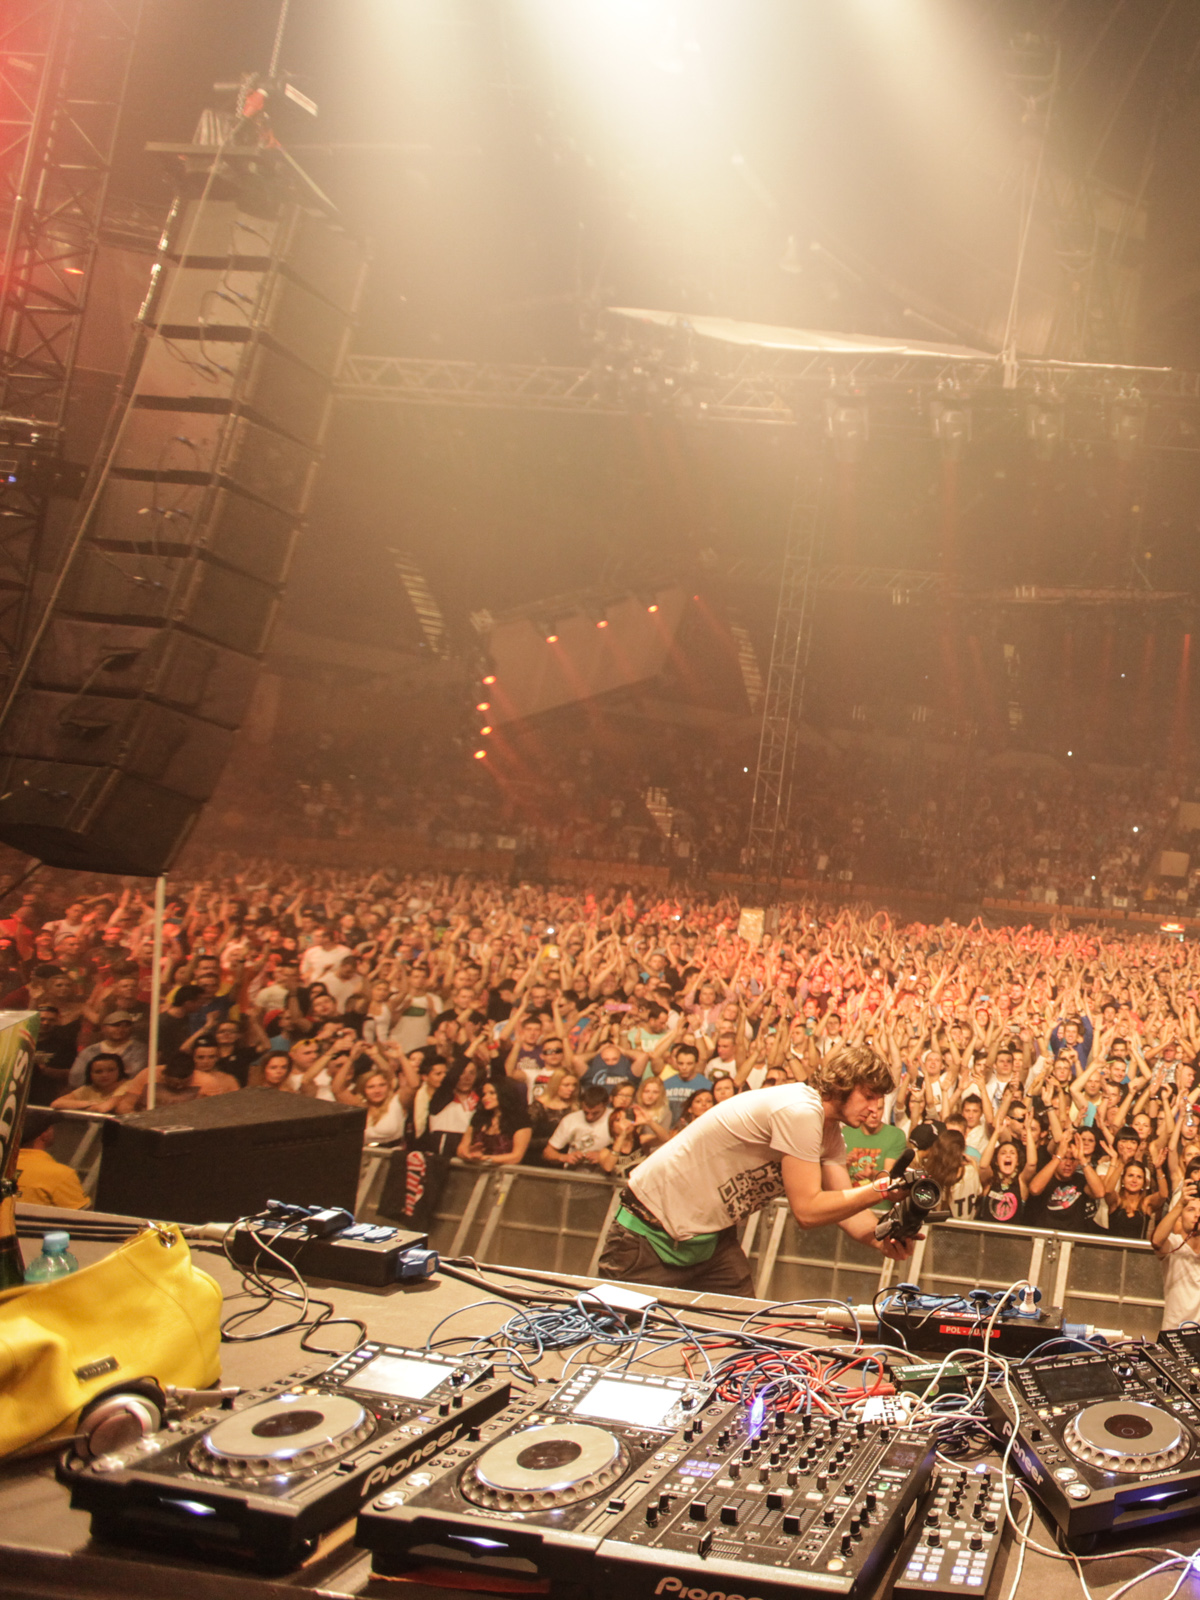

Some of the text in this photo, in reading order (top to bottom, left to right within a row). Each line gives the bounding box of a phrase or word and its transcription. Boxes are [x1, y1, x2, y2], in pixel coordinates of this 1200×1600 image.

[361, 1423, 463, 1497] Pioneer
[1002, 1421, 1044, 1485] Poneer
[1139, 1469, 1181, 1481] Pioneer
